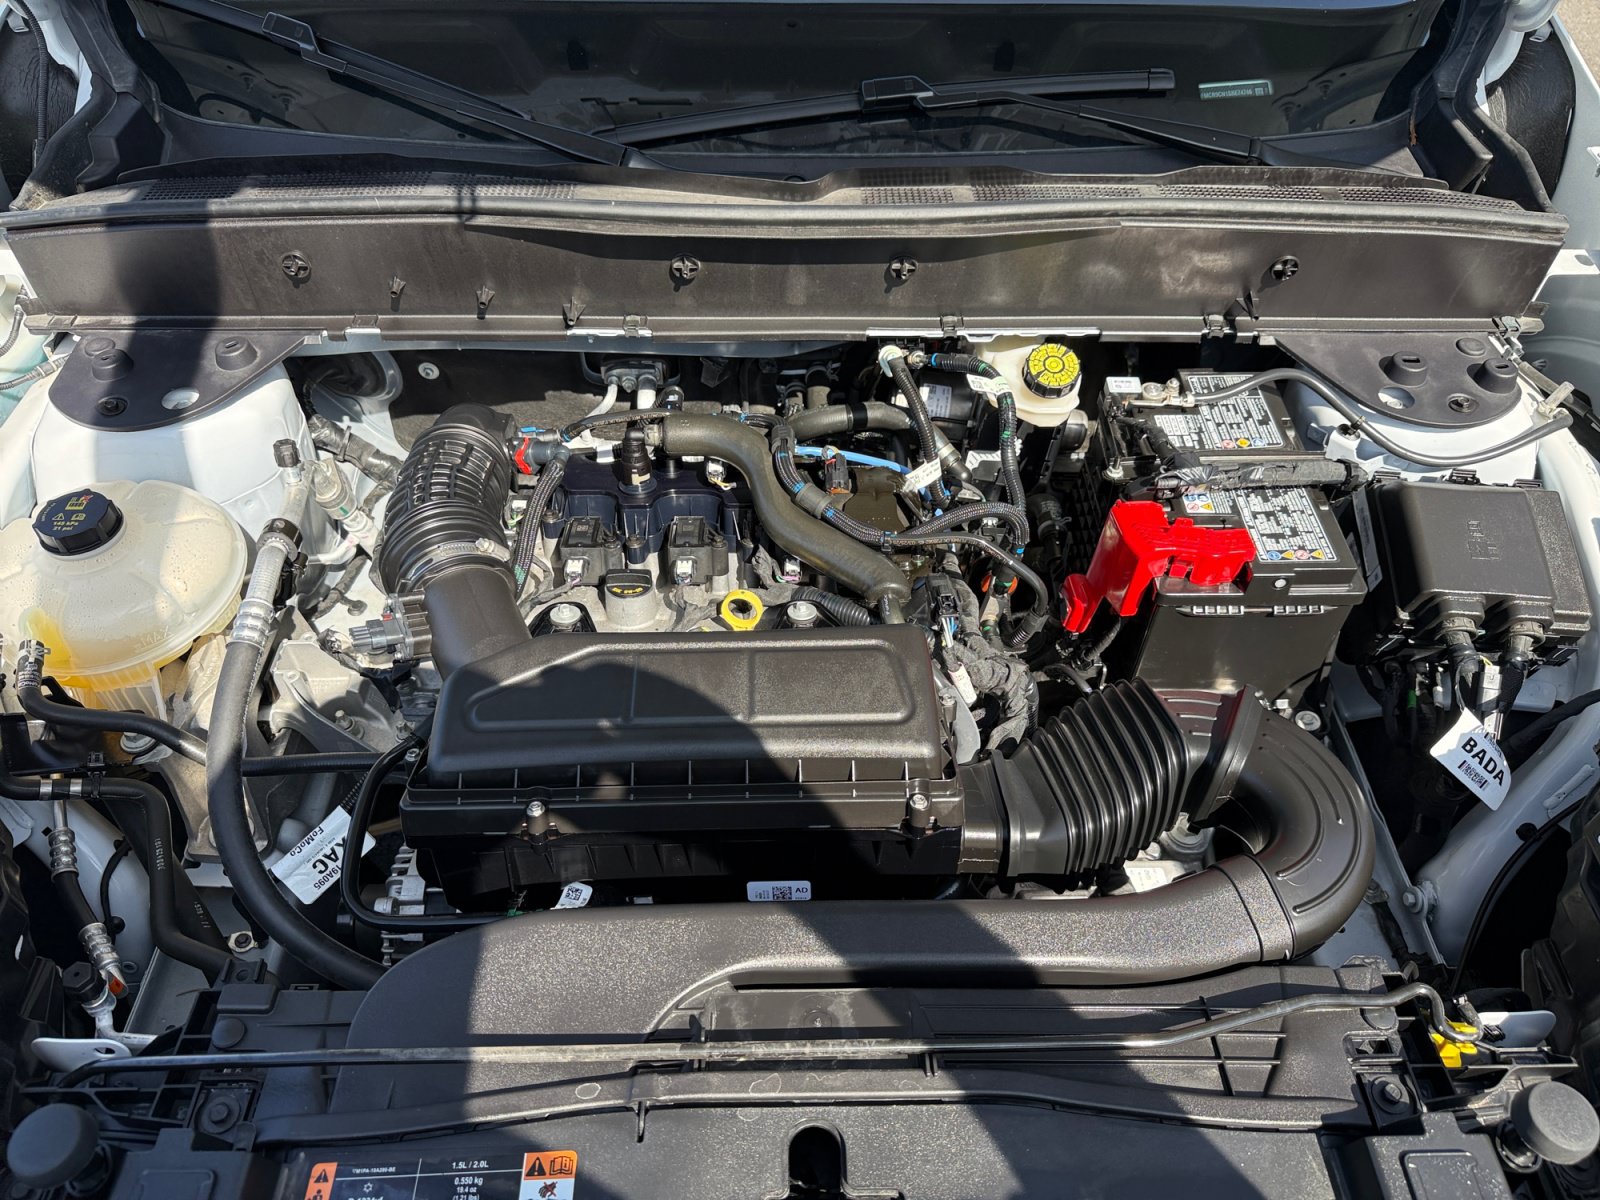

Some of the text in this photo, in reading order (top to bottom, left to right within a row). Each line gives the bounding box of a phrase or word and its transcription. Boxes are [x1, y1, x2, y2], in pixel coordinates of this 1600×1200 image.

[1460, 736, 1506, 786] BADA
[289, 826, 325, 857] FoMoCo
[313, 864, 342, 890] 19A095
[452, 1161, 467, 1169] 1.5L
[472, 1160, 489, 1168] 2.0L
[454, 1176, 484, 1186] 0.550 kg
